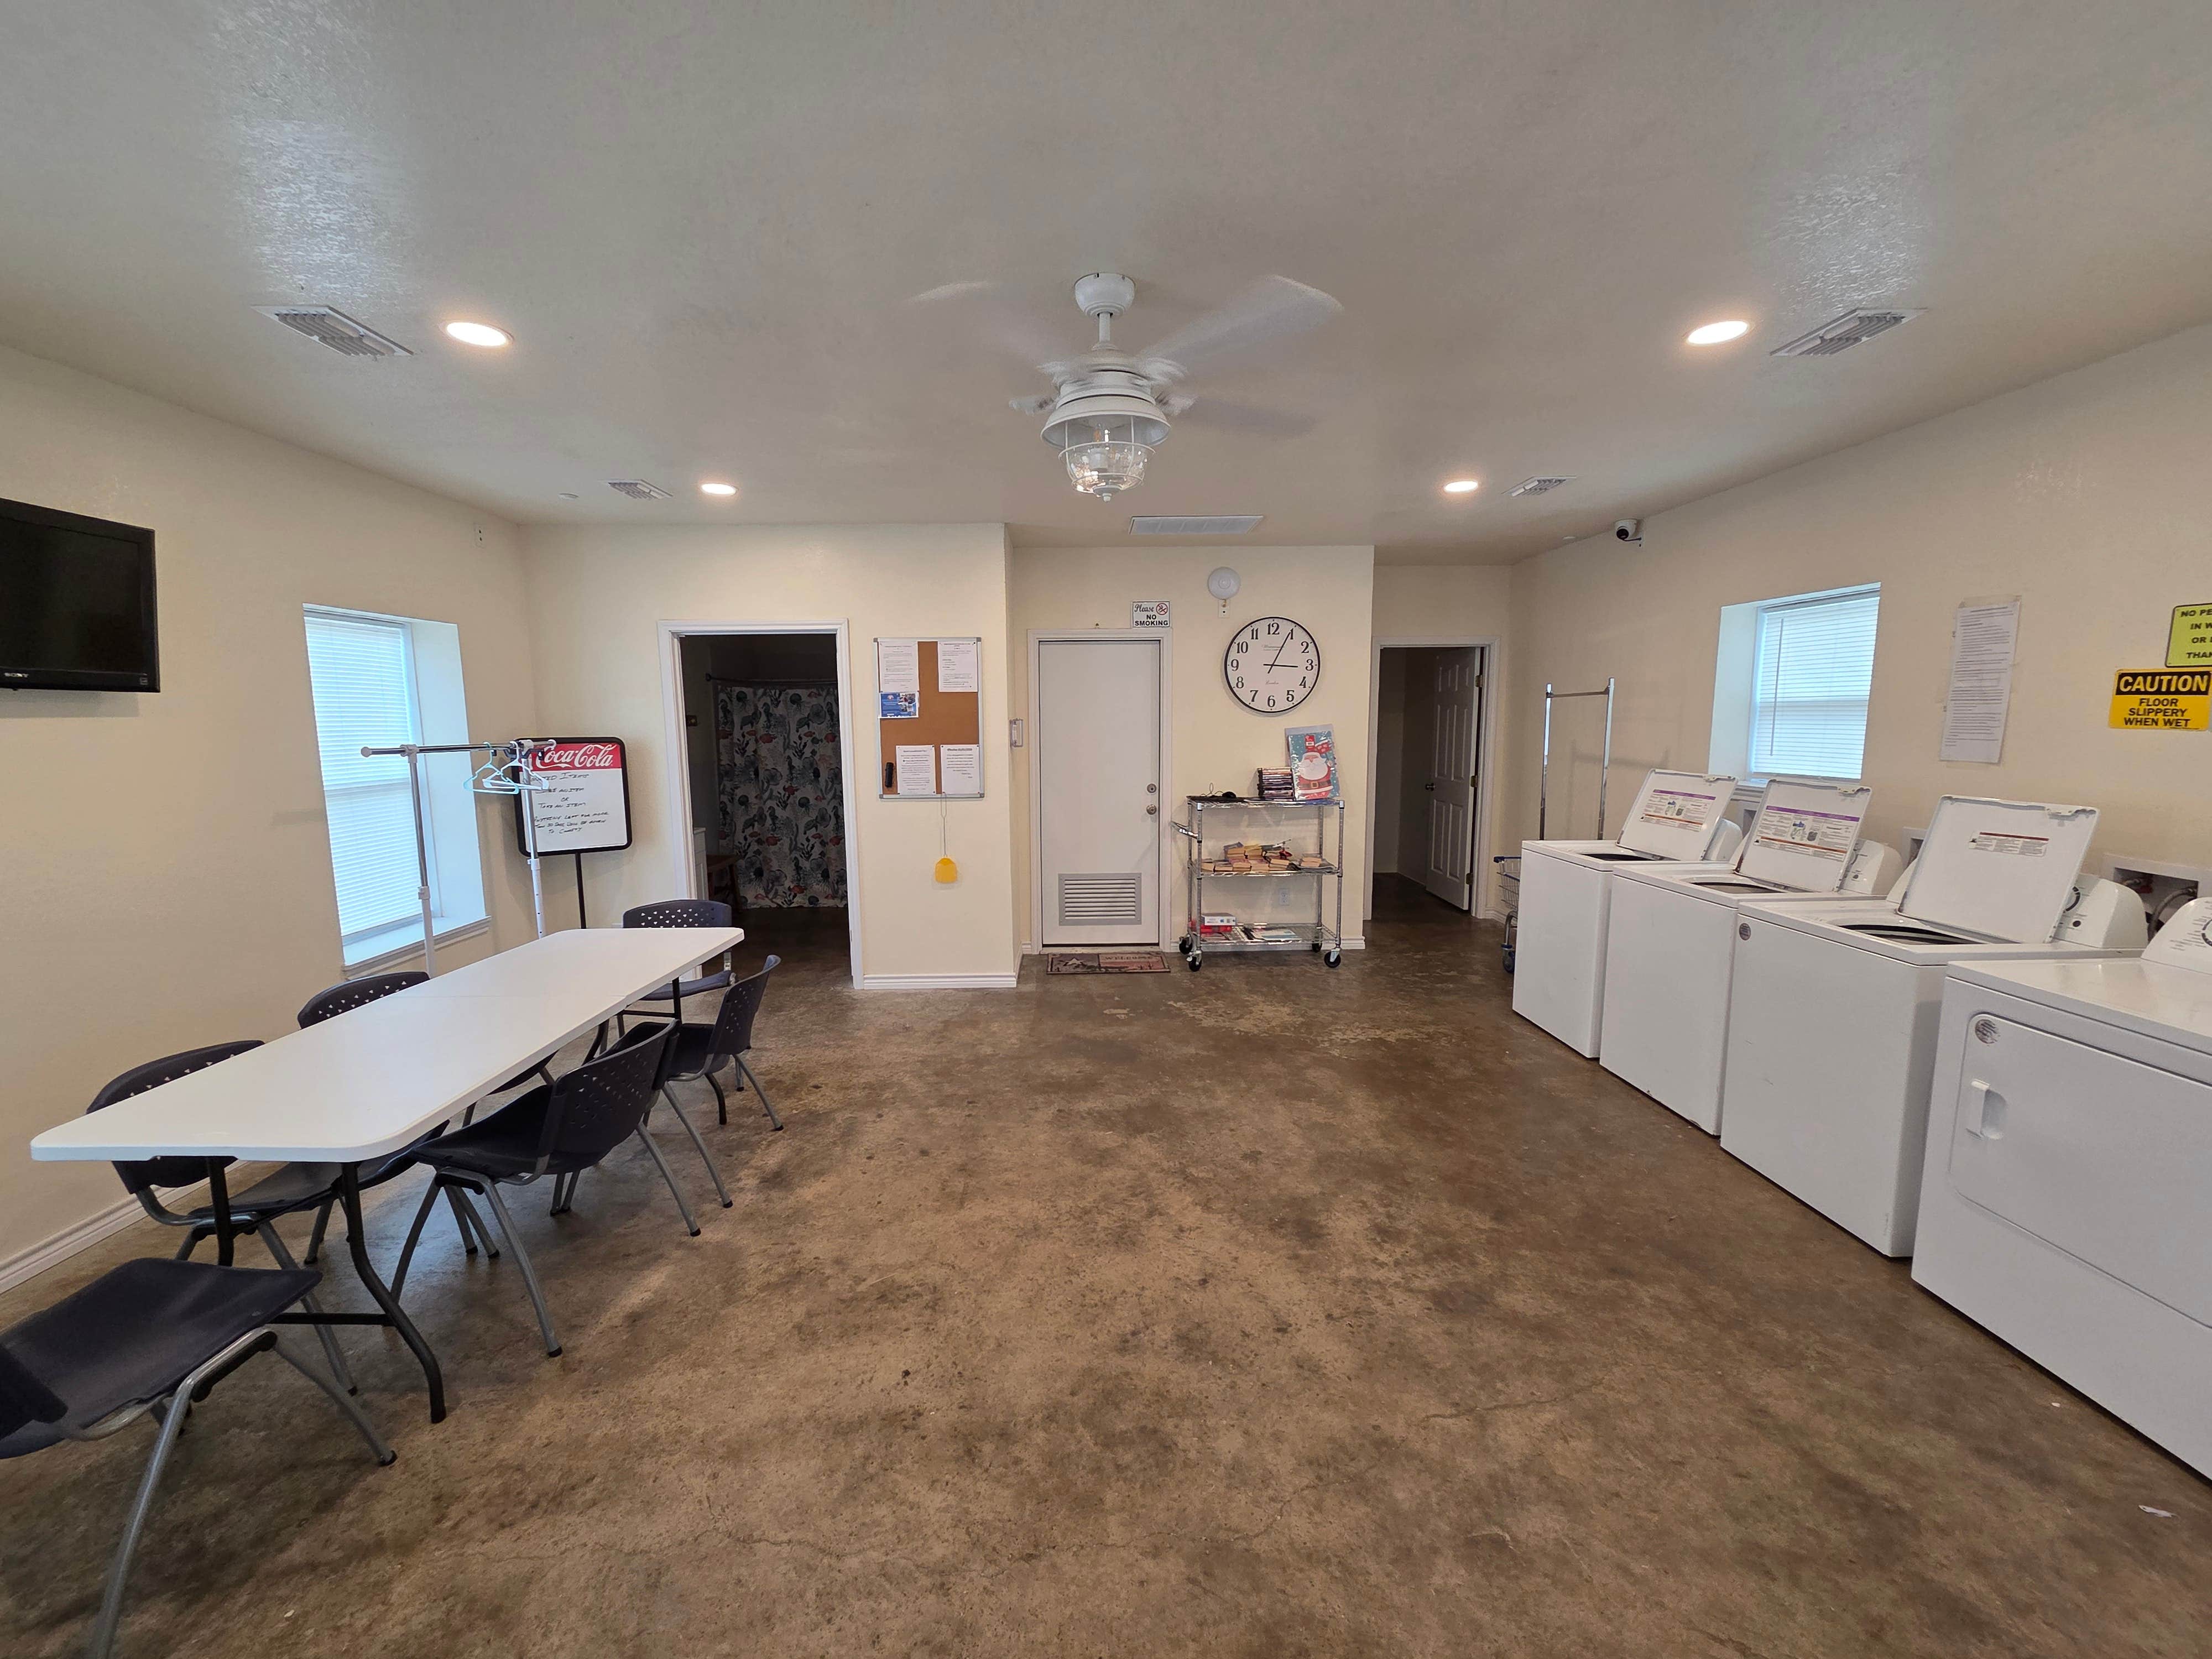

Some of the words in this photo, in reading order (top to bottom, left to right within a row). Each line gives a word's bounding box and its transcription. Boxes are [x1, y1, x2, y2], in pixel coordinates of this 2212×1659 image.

[1134, 603, 1154, 612] Please
[1251, 628, 1259, 640] 11
[1267, 622, 1280, 635] 12
[1290, 628, 1293, 640] 1
[1237, 641, 1249, 654] 10
[1301, 641, 1310, 653] 2
[1230, 659, 1239, 671] 9
[1305, 659, 1314, 671] 3
[1235, 676, 1244, 688] 8
[1299, 676, 1306, 688] 4
[2119, 675, 2208, 692] CAUTION
[1250, 690, 1259, 702] 7
[1267, 695, 1276, 707] 6
[1286, 690, 1295, 702] 5
[2139, 698, 2178, 707] FLOOR
[2128, 708, 2188, 717] SLIPPERY
[2124, 717, 2158, 726] WHEN
[2163, 718, 2191, 727] WET
